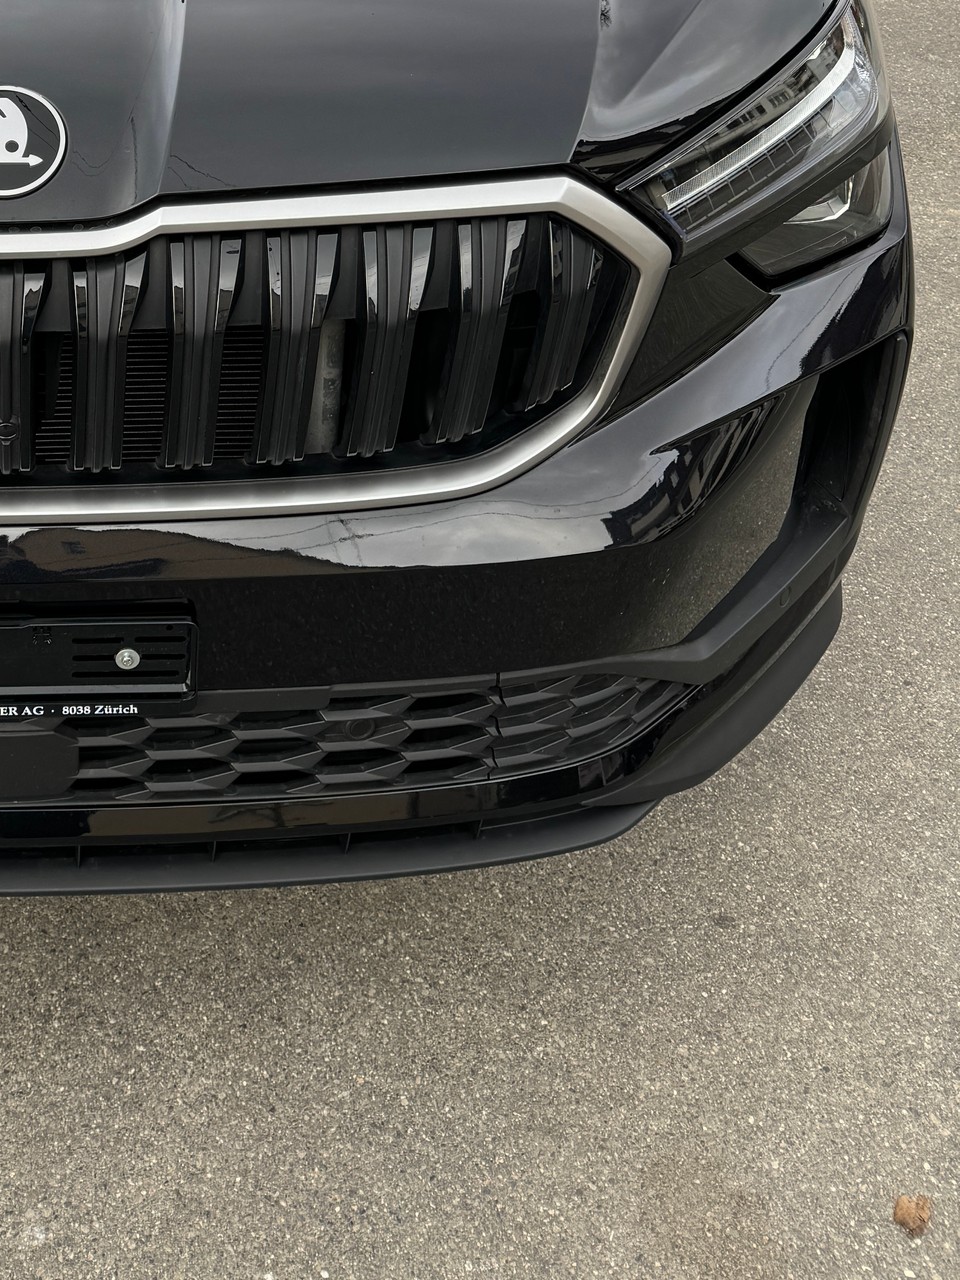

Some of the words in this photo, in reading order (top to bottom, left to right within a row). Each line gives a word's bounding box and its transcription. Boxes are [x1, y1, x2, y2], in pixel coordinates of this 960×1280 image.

[21, 705, 45, 717] AG
[61, 705, 91, 716] 8038
[94, 704, 138, 716] Zürich
